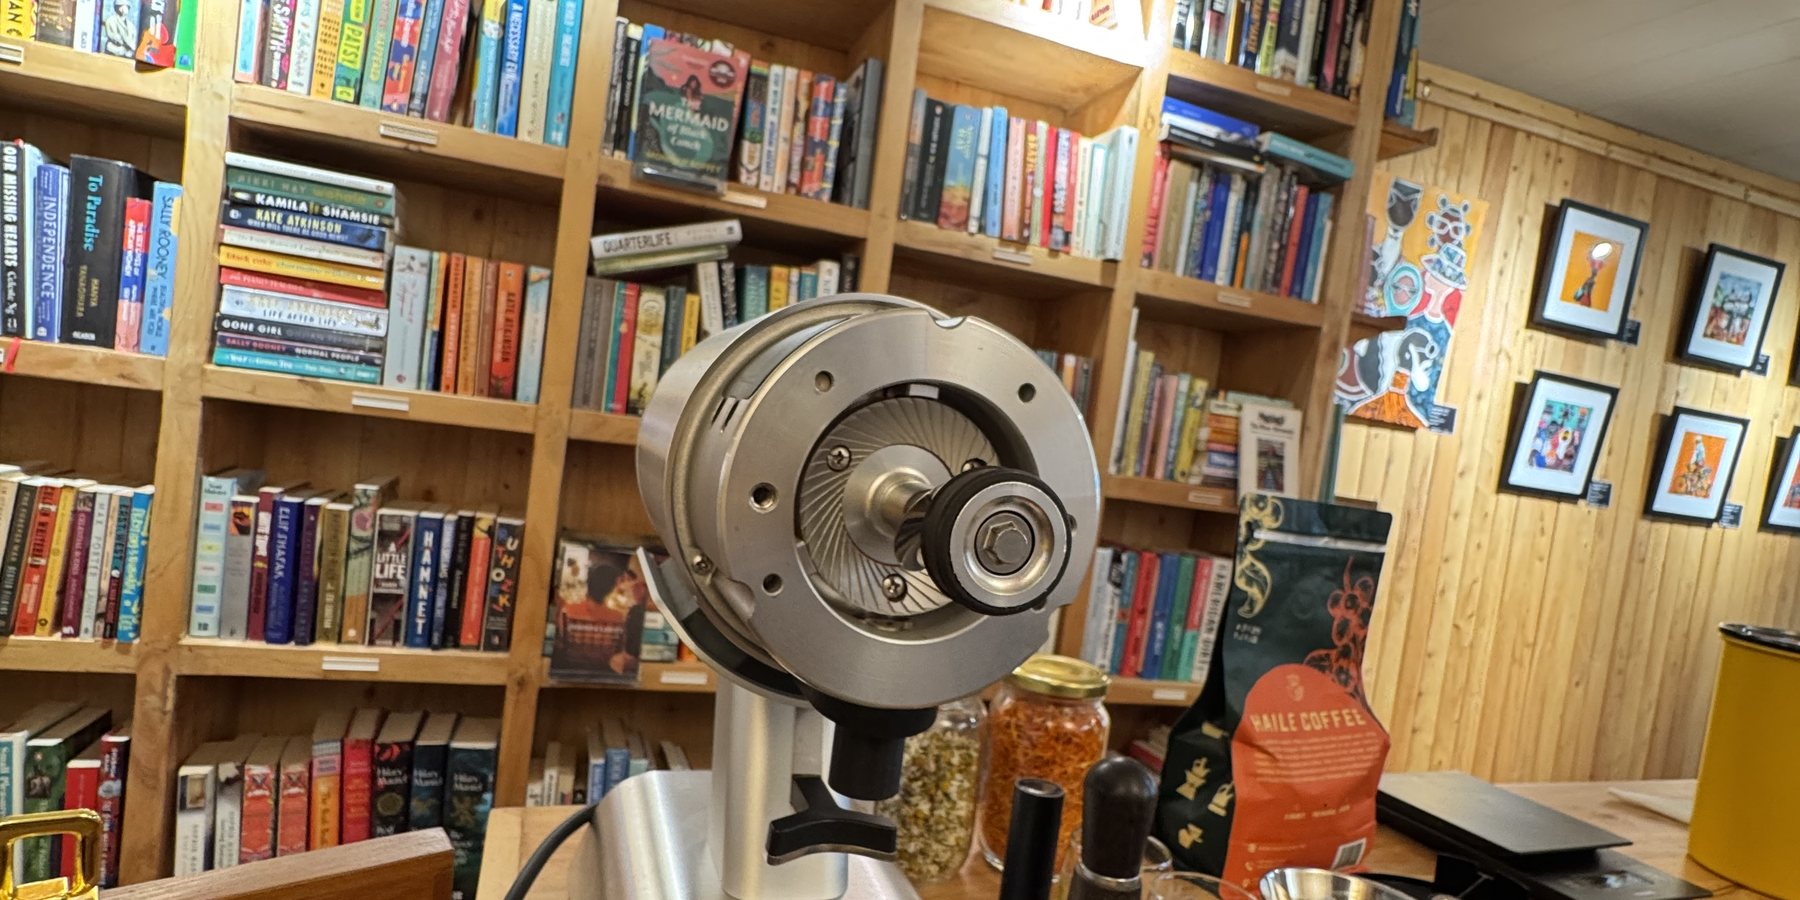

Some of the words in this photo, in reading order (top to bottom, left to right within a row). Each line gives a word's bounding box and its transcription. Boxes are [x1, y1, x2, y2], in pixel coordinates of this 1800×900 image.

[270, 3, 290, 53] SMITH
[648, 101, 729, 131] MERMAID
[3, 146, 17, 173] OUR
[88, 174, 103, 192] To
[3, 174, 18, 222] MISSING
[255, 193, 308, 212] KAMILA
[322, 205, 380, 225] SHAMSIE
[161, 195, 173, 226] SALLY
[256, 208, 283, 224] KATE
[286, 213, 343, 233] ATKINSON
[83, 195, 103, 252] Paradise
[4, 224, 18, 268] HEARTS
[41, 195, 57, 300] INDEPENDENCE
[155, 227, 171, 279] ROONEY
[602, 231, 672, 253] QUARTERLIFE
[7, 270, 17, 303] Celeste
[89, 278, 100, 308] HANYA
[505, 292, 516, 316] KATE
[221, 318, 253, 331] GONE
[257, 321, 282, 336] GIRL
[263, 309, 283, 319] LIFE
[287, 312, 315, 323] AFTER
[318, 317, 337, 327] LIFE
[225, 337, 250, 347] SALLY
[252, 340, 287, 351] ROONEY
[501, 318, 514, 363] ATKINSON
[295, 347, 329, 358] NORMAL
[330, 352, 360, 362] PEOPLE
[95, 503, 105, 526] MAX
[279, 507, 290, 529] ELIF
[89, 536, 103, 579] PORTER
[273, 532, 289, 580] SHAFAK
[377, 553, 406, 564] LITTLE
[388, 541, 397, 553] A
[375, 564, 406, 580] LIFE
[415, 531, 434, 635] HAMNET
[1250, 713, 1297, 733] HAILE
[1300, 708, 1366, 731] COFFEE
[376, 767, 402, 777] Hilary
[377, 776, 408, 786] Mantel
[414, 768, 438, 778] Hilary
[415, 777, 443, 787] Mantel
[453, 773, 478, 783] Hilary
[454, 782, 483, 792] Mantel
